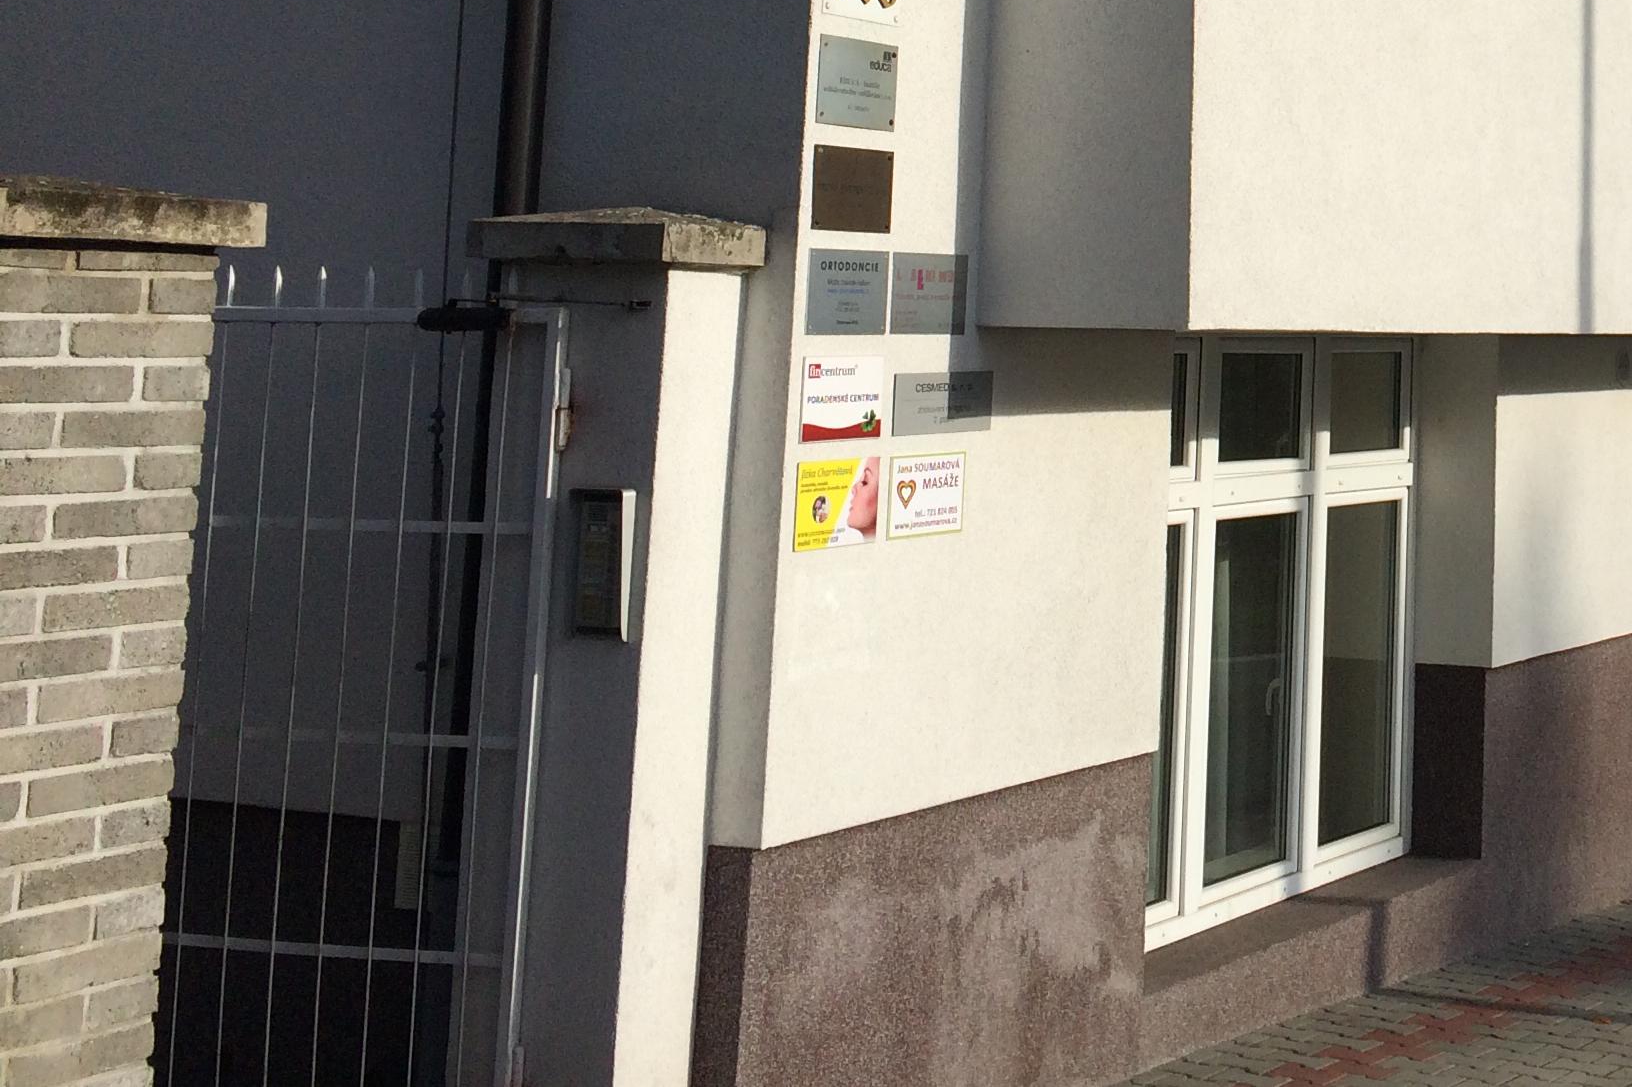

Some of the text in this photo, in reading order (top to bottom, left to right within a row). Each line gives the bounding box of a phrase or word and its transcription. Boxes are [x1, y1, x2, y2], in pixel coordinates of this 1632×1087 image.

[870, 60, 892, 73] educa
[820, 260, 879, 273] ORTODONCIE
[850, 393, 879, 403] CENTRUM
[922, 473, 959, 490] MASÁŽE
